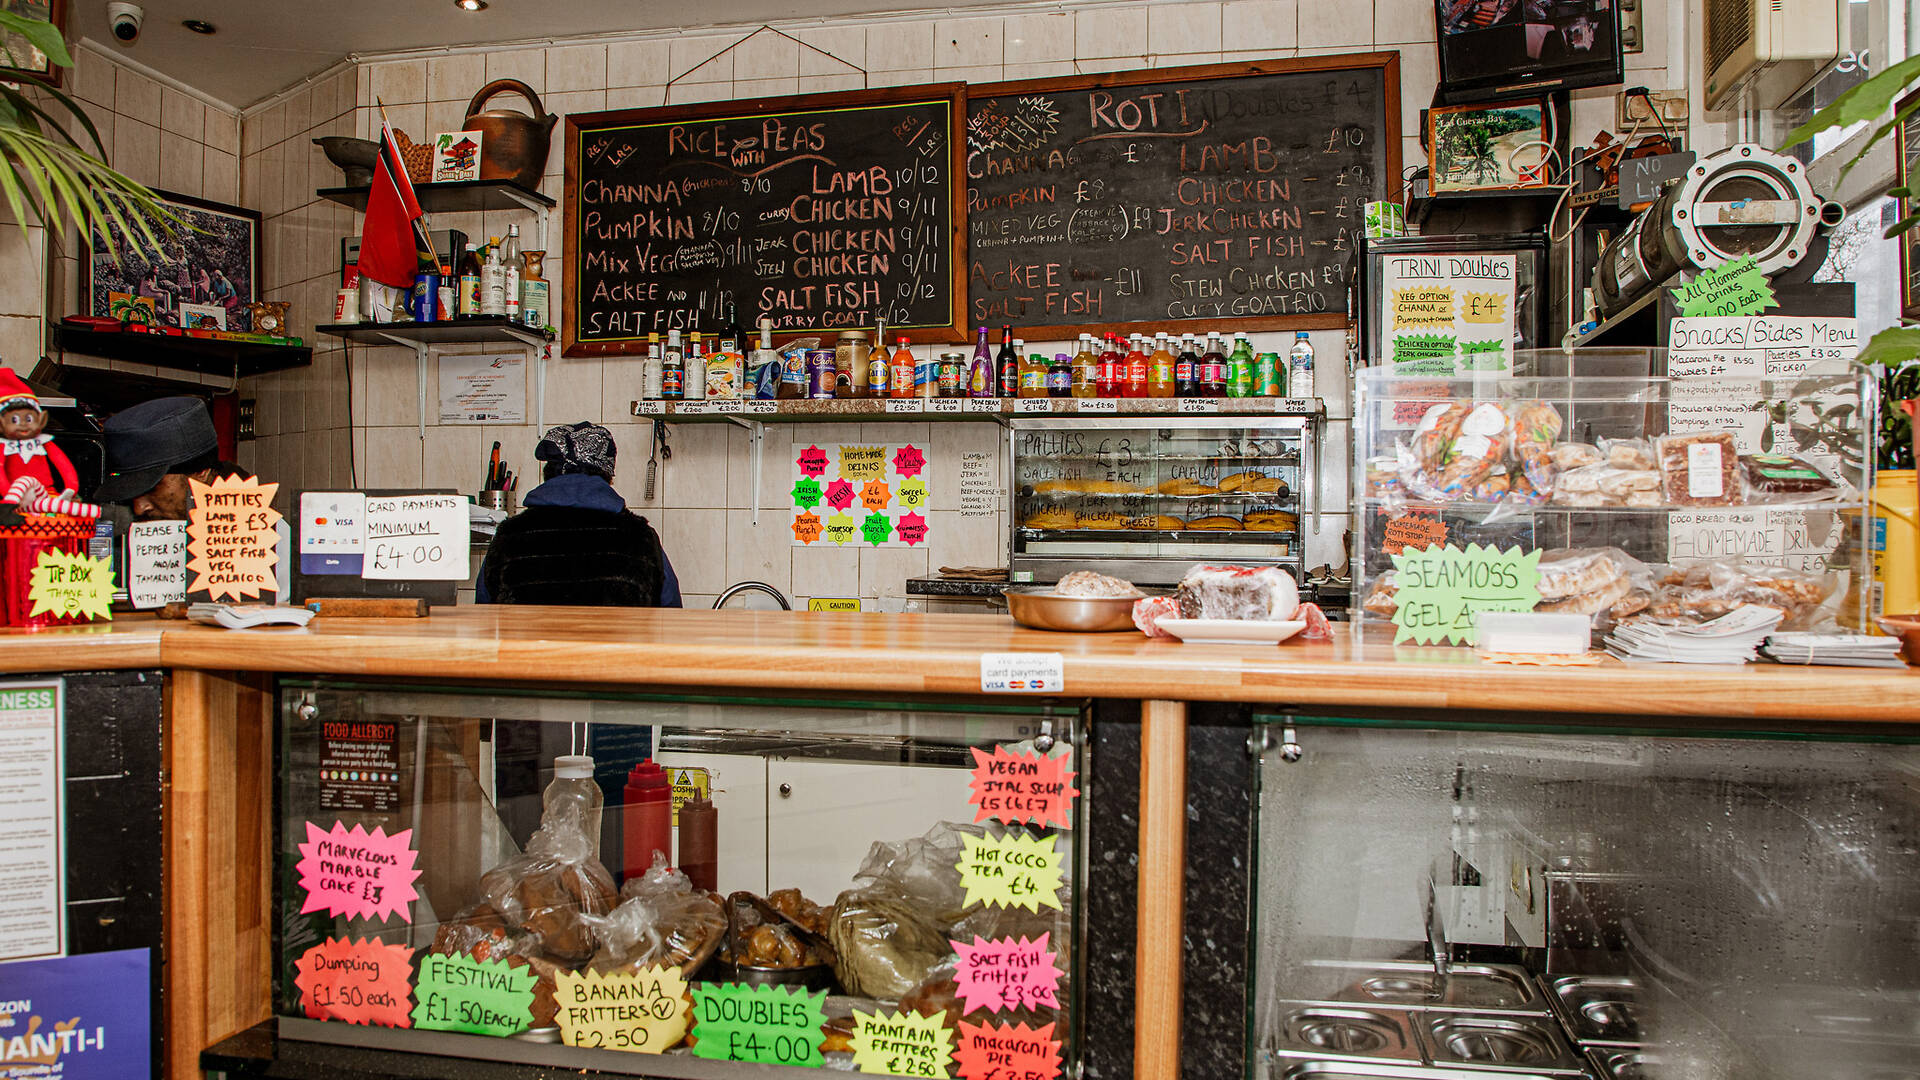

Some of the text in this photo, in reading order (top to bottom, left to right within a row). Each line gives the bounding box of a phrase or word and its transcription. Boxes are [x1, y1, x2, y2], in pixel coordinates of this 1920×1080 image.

[1457, 116, 1485, 127] Cuevas
[1487, 114, 1503, 124] Bay
[670, 118, 825, 156] RICE PEAS
[732, 151, 765, 167] WITH
[1181, 136, 1278, 173] LAMB
[813, 157, 939, 196] LAMB 10/12
[1636, 158, 1661, 177] NO
[1178, 178, 1290, 206] CHICKEN
[759, 192, 935, 223] CURRY CHICKEN 9/11
[1027, 213, 1062, 231] VEG
[1156, 206, 1301, 235] JERK CHICKEN
[756, 219, 937, 254] JERK CHICKEN 9/11
[636, 243, 674, 273] VEG
[1170, 236, 1304, 265] SALT FISH
[754, 245, 937, 278] STEW CHICKEN 9/11
[1392, 259, 1441, 277] TRINI
[970, 259, 1061, 290] ACKEE
[1169, 264, 1344, 299] STEW CHICKEN £9
[592, 280, 659, 302] ACKEE
[759, 274, 935, 311] SALT FISH 10/12
[1684, 283, 1705, 303] All
[1706, 282, 1743, 303] Drinks
[1740, 290, 1763, 306] Each
[975, 288, 1102, 320] SALT FISH
[1232, 291, 1326, 315] GOAT £10
[1398, 304, 1435, 312] CHANNA
[1470, 297, 1497, 315] £4
[588, 309, 698, 335] SALT FISH
[756, 311, 869, 329] CURRY GOAT
[1674, 319, 1857, 349] Snacks/Sides Menu
[1670, 354, 1710, 364] Macaroni
[1811, 350, 1841, 358] £3.00
[1670, 368, 1707, 376] Doubles
[848, 462, 879, 471] DRINKS
[1105, 471, 1141, 483] EACH
[205, 494, 263, 508] PATTIES
[368, 500, 456, 513] CARD PAYMENTS
[1022, 503, 1067, 516] CHICKEN
[206, 512, 268, 531] LAMB £3
[1074, 510, 1116, 522] CHICKEN
[1119, 516, 1157, 527] CHEESE
[1695, 515, 1725, 523] BREAD
[135, 525, 172, 537] PLEASE
[207, 525, 238, 534] BEEF
[369, 521, 430, 535] MINIMUM
[796, 525, 816, 534] Punch
[865, 525, 885, 533] Punch
[1407, 531, 1424, 540] STOP
[1425, 535, 1442, 544] HOT
[136, 544, 168, 556] PEPPER
[206, 536, 257, 546] CHICKEN
[1674, 529, 1775, 558] HOMEMADE
[207, 548, 266, 559] SALT FISH
[375, 544, 442, 570] £4.00
[44, 564, 92, 583] TIP BOX
[209, 561, 234, 572] VEG
[1405, 560, 1519, 589] SEAMOSS
[46, 588, 82, 598] THANK
[135, 593, 157, 601] WITH
[1403, 601, 1448, 628] GEL
[987, 668, 1058, 679] card payments
[324, 722, 394, 740] FOOD ALLERGY?
[989, 761, 1038, 776] VEGAN
[984, 781, 1065, 796] ITAL SOUP
[318, 841, 398, 866] MARVELOUS
[976, 847, 1047, 868] HOT COCO
[320, 861, 382, 879] MARBLE
[971, 865, 1003, 877] TEA
[320, 879, 355, 894] CAKE
[1008, 876, 1038, 895] £4
[315, 953, 379, 982] Dumpling
[969, 953, 1000, 968] SALT
[431, 962, 523, 993] FESTIVAL
[314, 983, 396, 1008] £1.50 each
[574, 980, 663, 1002] BANANA
[427, 992, 520, 1030] £1.50 EACH
[569, 1005, 650, 1025] FRITTERS
[704, 996, 808, 1028] DOUBLES
[864, 1021, 936, 1044] PLANTAIN
[729, 1032, 810, 1062] £4.00
[871, 1039, 938, 1062] FRITTERS
